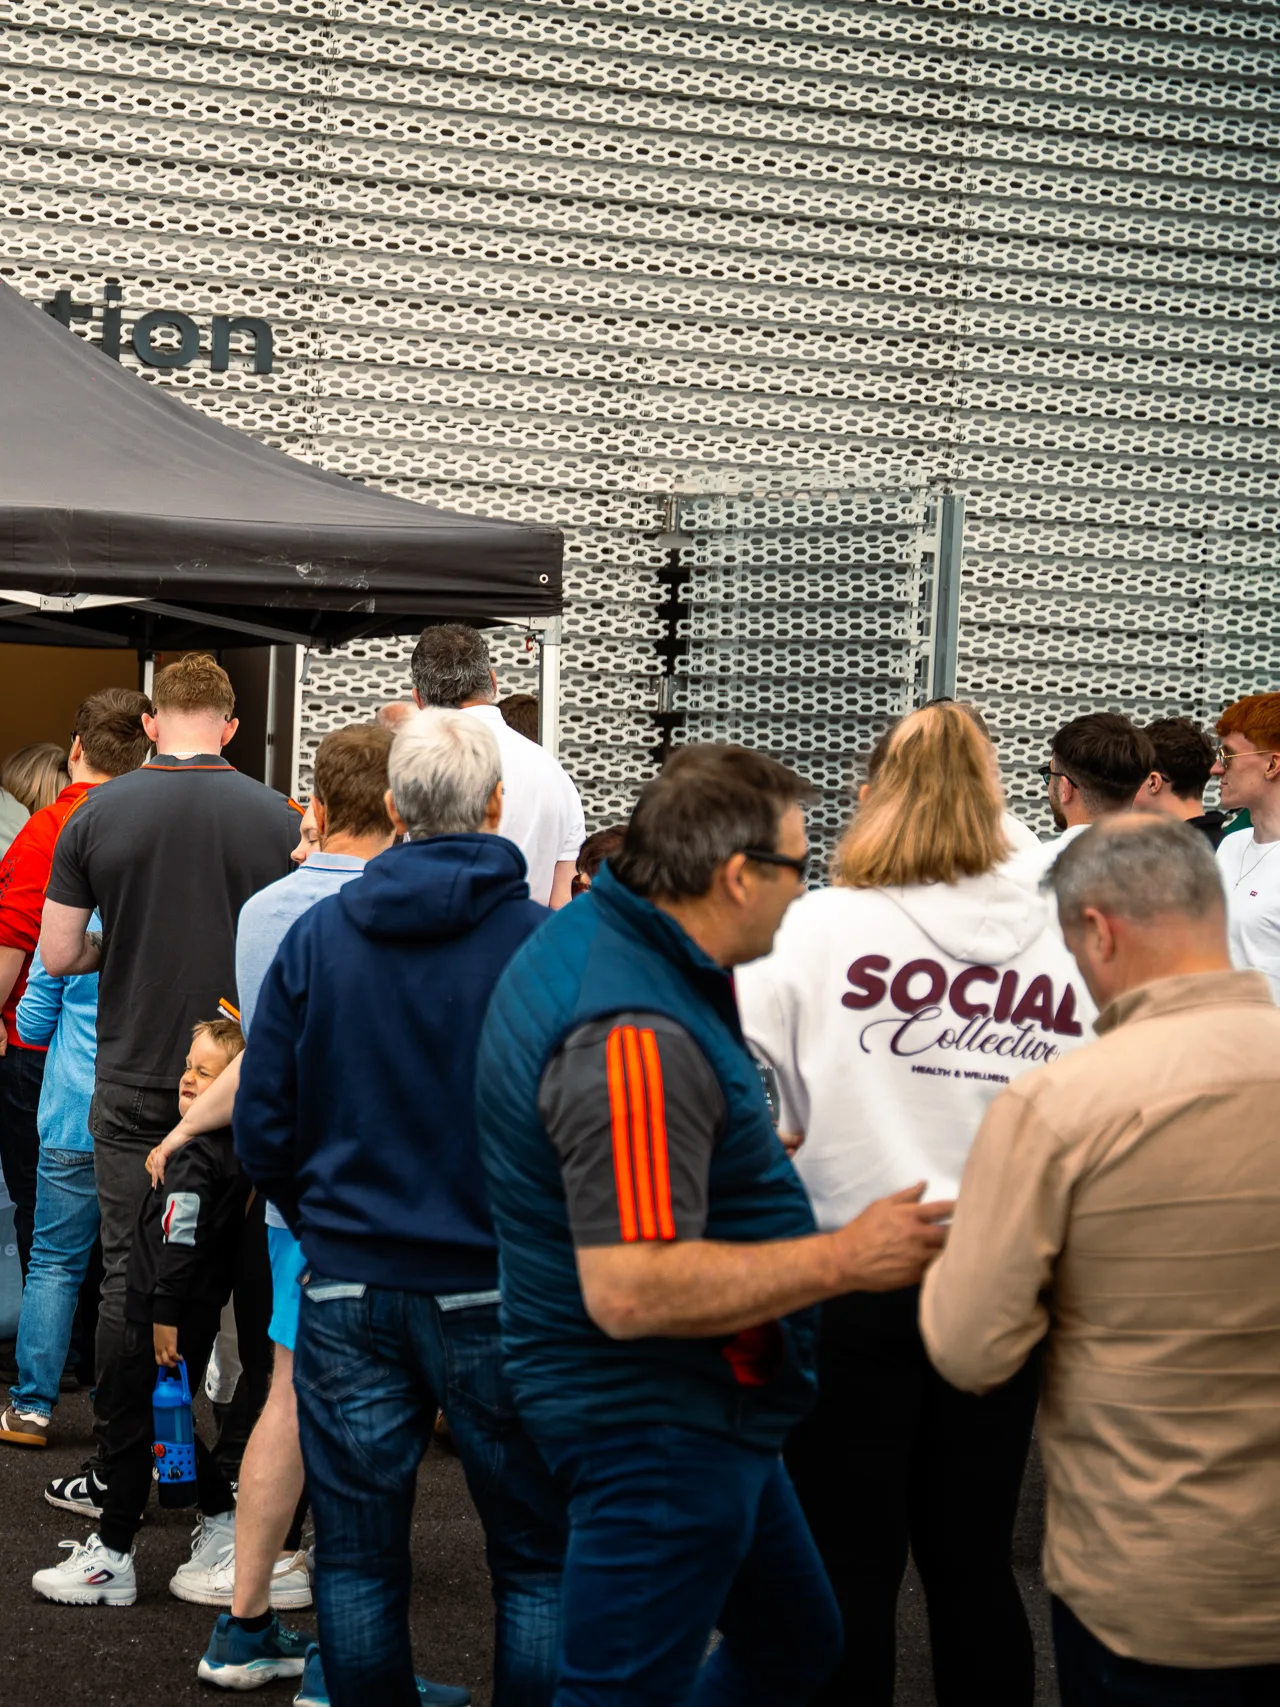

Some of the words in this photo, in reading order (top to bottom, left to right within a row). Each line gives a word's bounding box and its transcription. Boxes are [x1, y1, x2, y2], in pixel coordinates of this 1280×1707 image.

[841, 954, 1082, 1037] SOCIAL
[860, 1006, 1060, 1063] Collective
[911, 1065, 951, 1078] HEALTH
[954, 1070, 961, 1078] &
[964, 1071, 1010, 1084] WELLNESS
